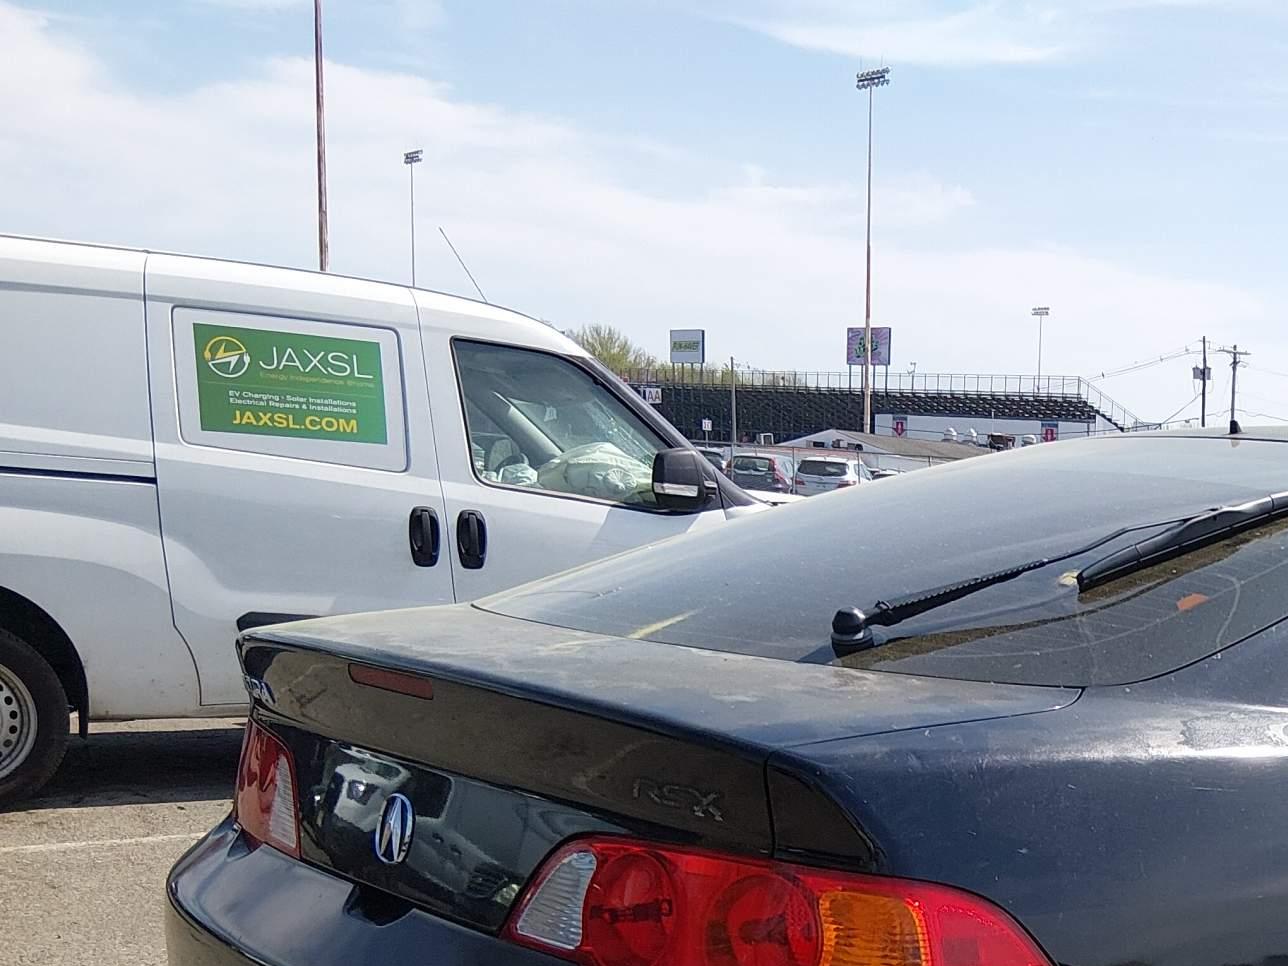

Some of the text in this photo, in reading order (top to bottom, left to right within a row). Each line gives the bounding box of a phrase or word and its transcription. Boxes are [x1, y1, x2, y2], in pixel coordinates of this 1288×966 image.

[259, 346, 374, 379] JAXSL
[229, 398, 357, 414] Electrical Repairs & Installations
[242, 391, 280, 401] Charging
[285, 394, 307, 403] Solar
[308, 396, 357, 407] Installations
[232, 410, 358, 433] JAXSL.COM
[632, 779, 727, 823] RSX
